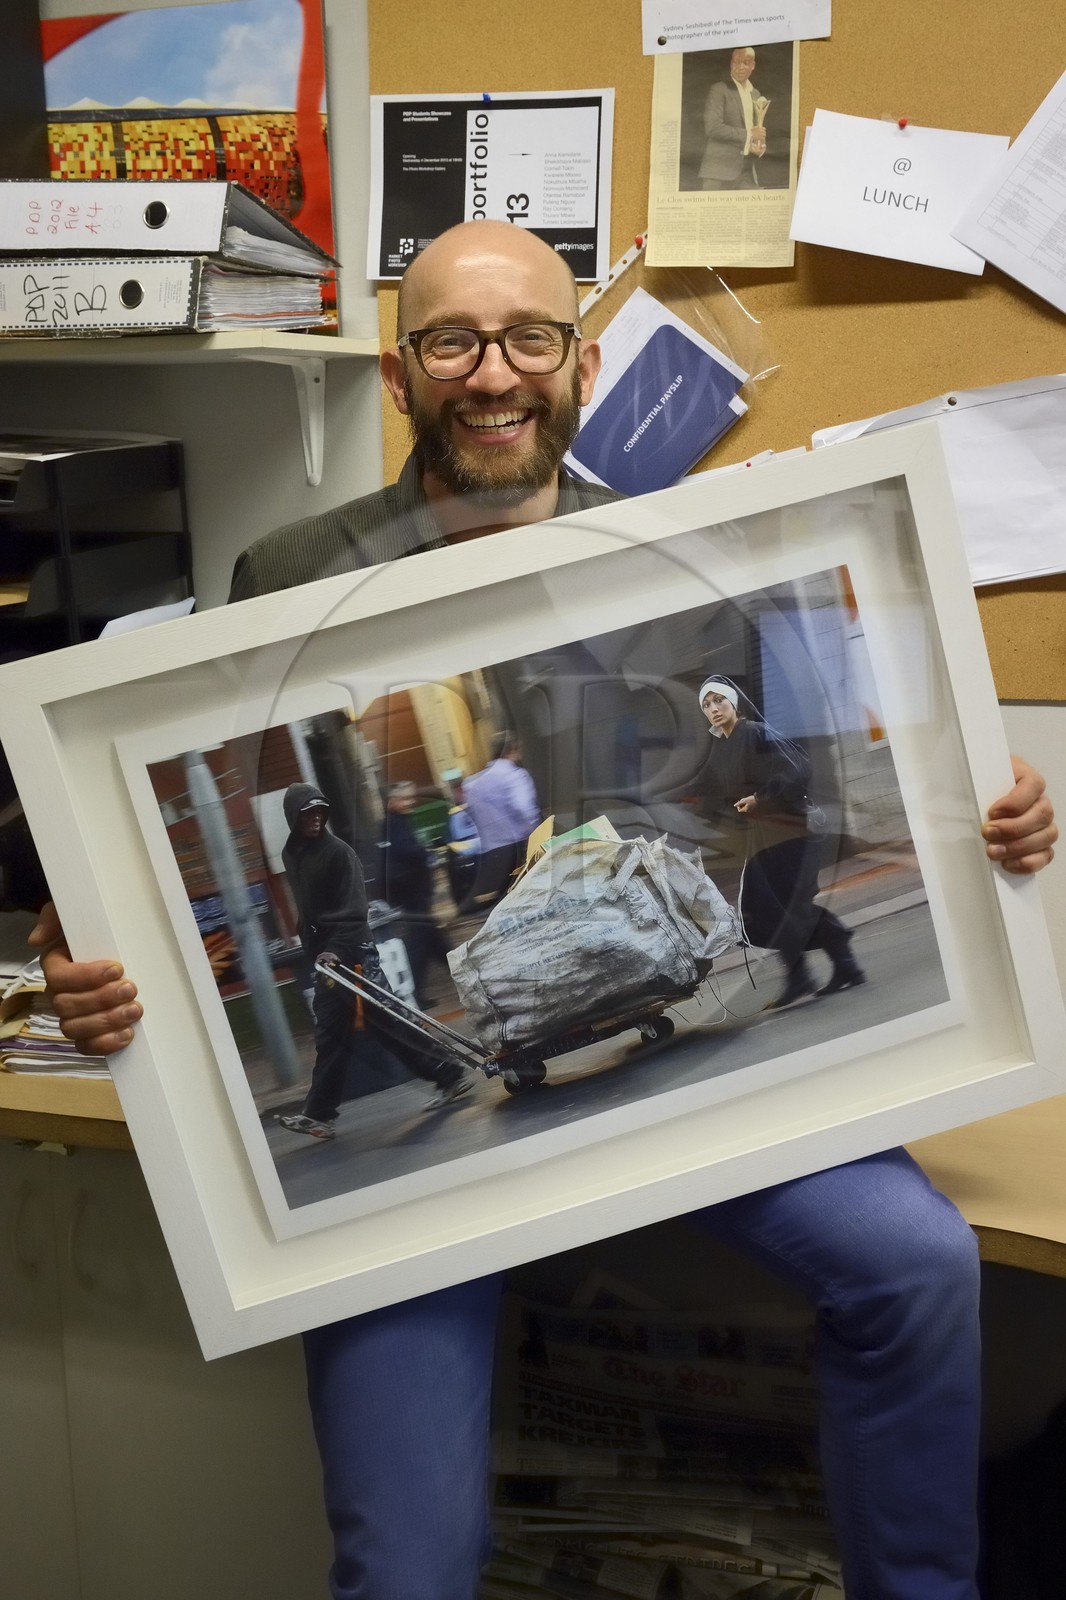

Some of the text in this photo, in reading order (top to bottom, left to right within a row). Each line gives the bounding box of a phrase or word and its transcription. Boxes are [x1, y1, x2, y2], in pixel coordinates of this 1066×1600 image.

[665, 32, 704, 41] hotographer
[724, 28, 738, 36] year!
[685, 21, 713, 29] Seshibedi
[766, 15, 785, 23] sports
[892, 157, 912, 176] @
[720, 196, 733, 204] way
[763, 194, 785, 202] hearts
[862, 186, 929, 213] LUNCH
[46, 199, 64, 235] 2012
[65, 205, 80, 230] File
[554, 243, 594, 252] gettyimages
[23, 274, 50, 323] PDP
[52, 275, 71, 326] 2011
[74, 284, 107, 316] B
[623, 374, 684, 453] CONFIDENTIAL PAYSLIP
[518, 1384, 640, 1423] TAXMAN
[518, 1402, 646, 1438] TARGETS
